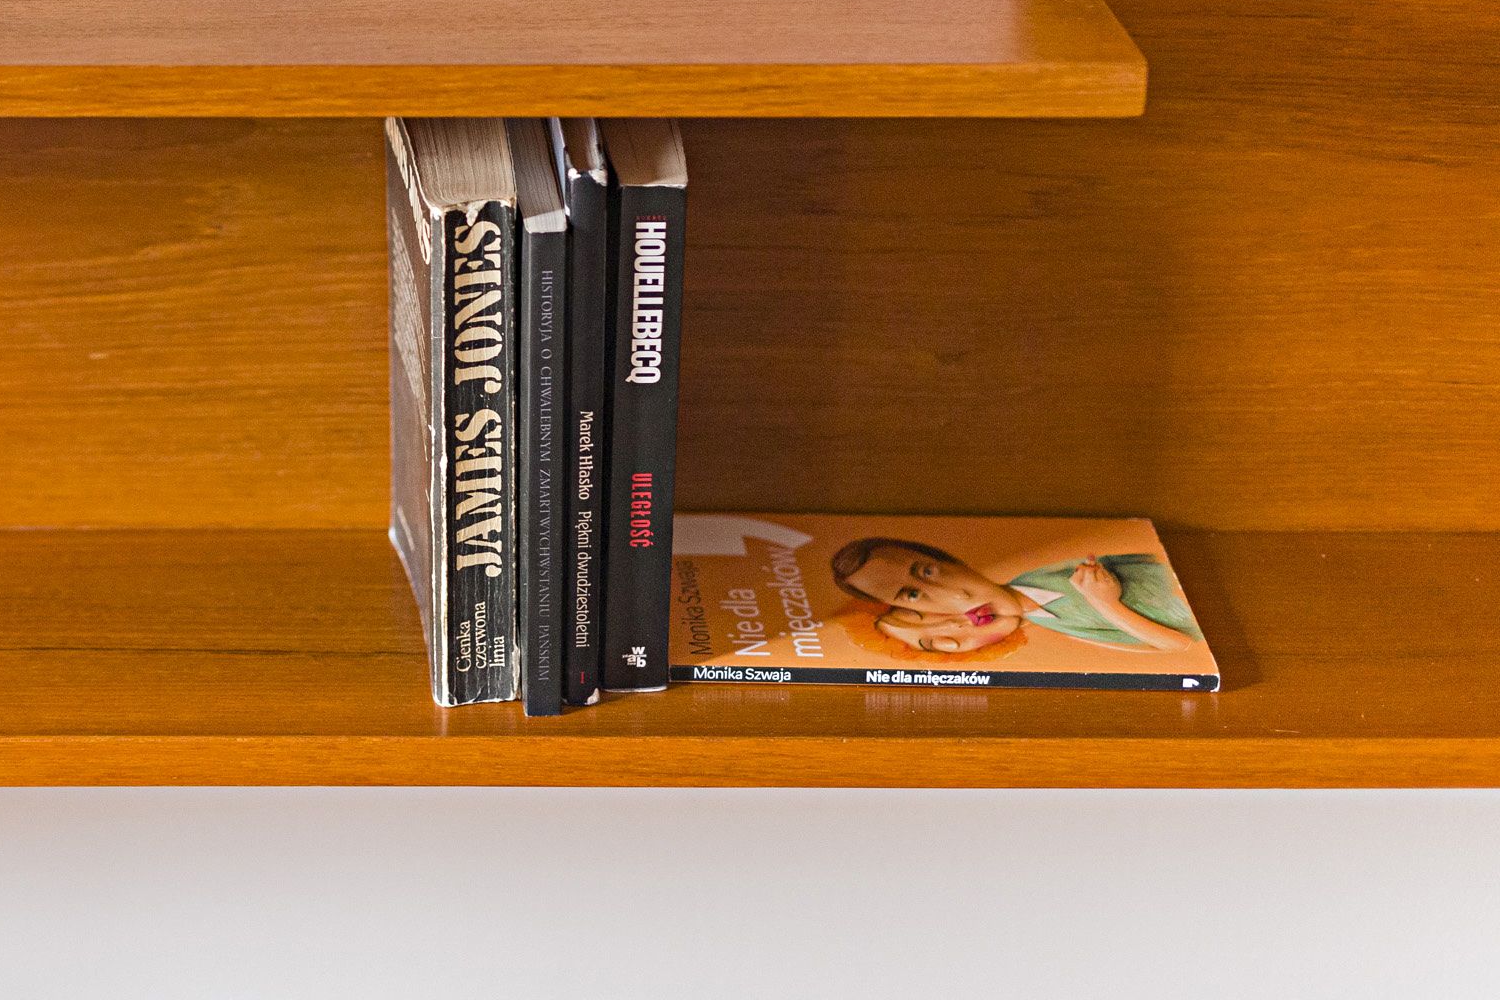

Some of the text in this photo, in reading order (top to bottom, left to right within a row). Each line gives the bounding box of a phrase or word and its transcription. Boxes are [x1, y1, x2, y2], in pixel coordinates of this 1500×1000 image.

[625, 221, 667, 384] HOUELLEBECQ
[454, 221, 503, 578] JAMES JONES
[537, 270, 553, 681] HISTORYJA O CHWALEBNYM ZMARTWYCHWSTANIU PAŃSKIM
[575, 411, 594, 648] Marek Hłasko Piękni dwudziestoletni
[630, 473, 653, 548] ULEGŁOŚĆ
[474, 601, 487, 669] czerwona
[681, 604, 713, 655] Monika
[719, 588, 772, 656] Nie dla
[761, 548, 824, 658] mięczaków
[455, 620, 472, 672] Cienka
[488, 635, 505, 668] linia
[693, 666, 792, 682] Monika Szwaja
[866, 670, 990, 686] Nie dla mięczaków
